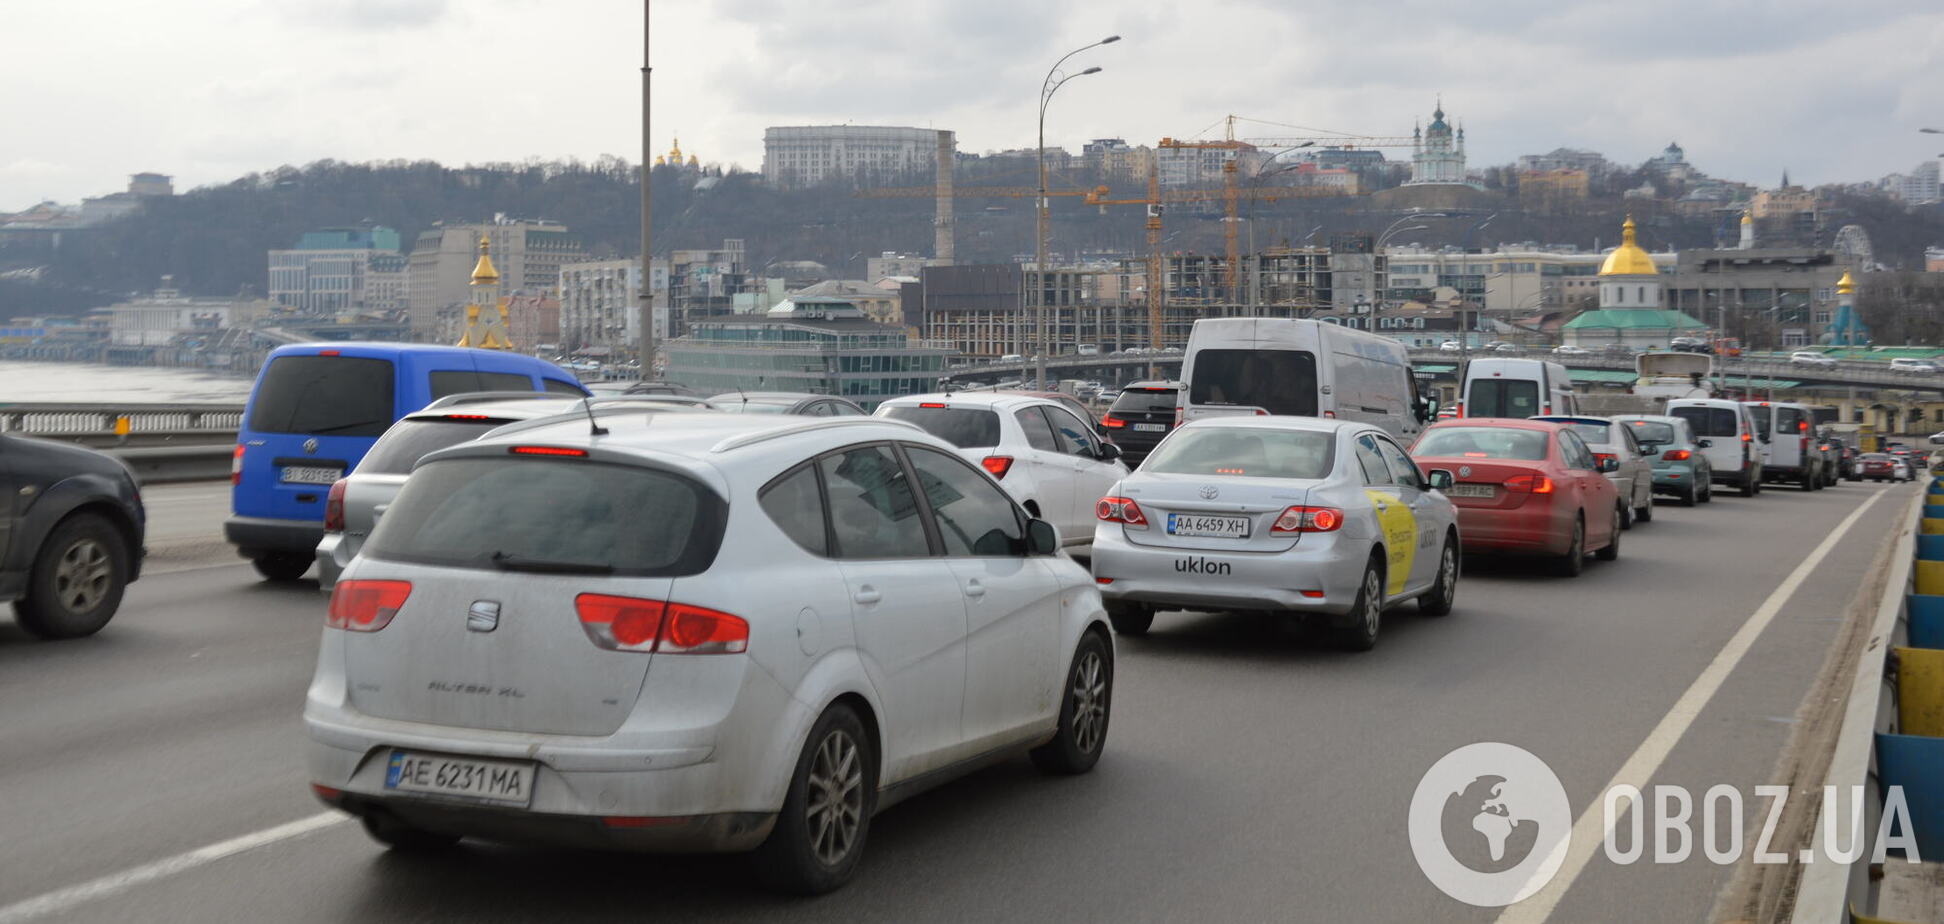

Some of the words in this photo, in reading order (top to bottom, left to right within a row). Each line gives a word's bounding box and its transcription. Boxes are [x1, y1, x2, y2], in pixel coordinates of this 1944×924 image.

[1175, 517, 1193, 530] AA
[1195, 518, 1224, 532] 6459
[1226, 519, 1245, 533] XH
[1174, 555, 1232, 576] uklon
[398, 759, 432, 786] AE
[436, 762, 486, 791] 6231
[488, 768, 521, 796] MA
